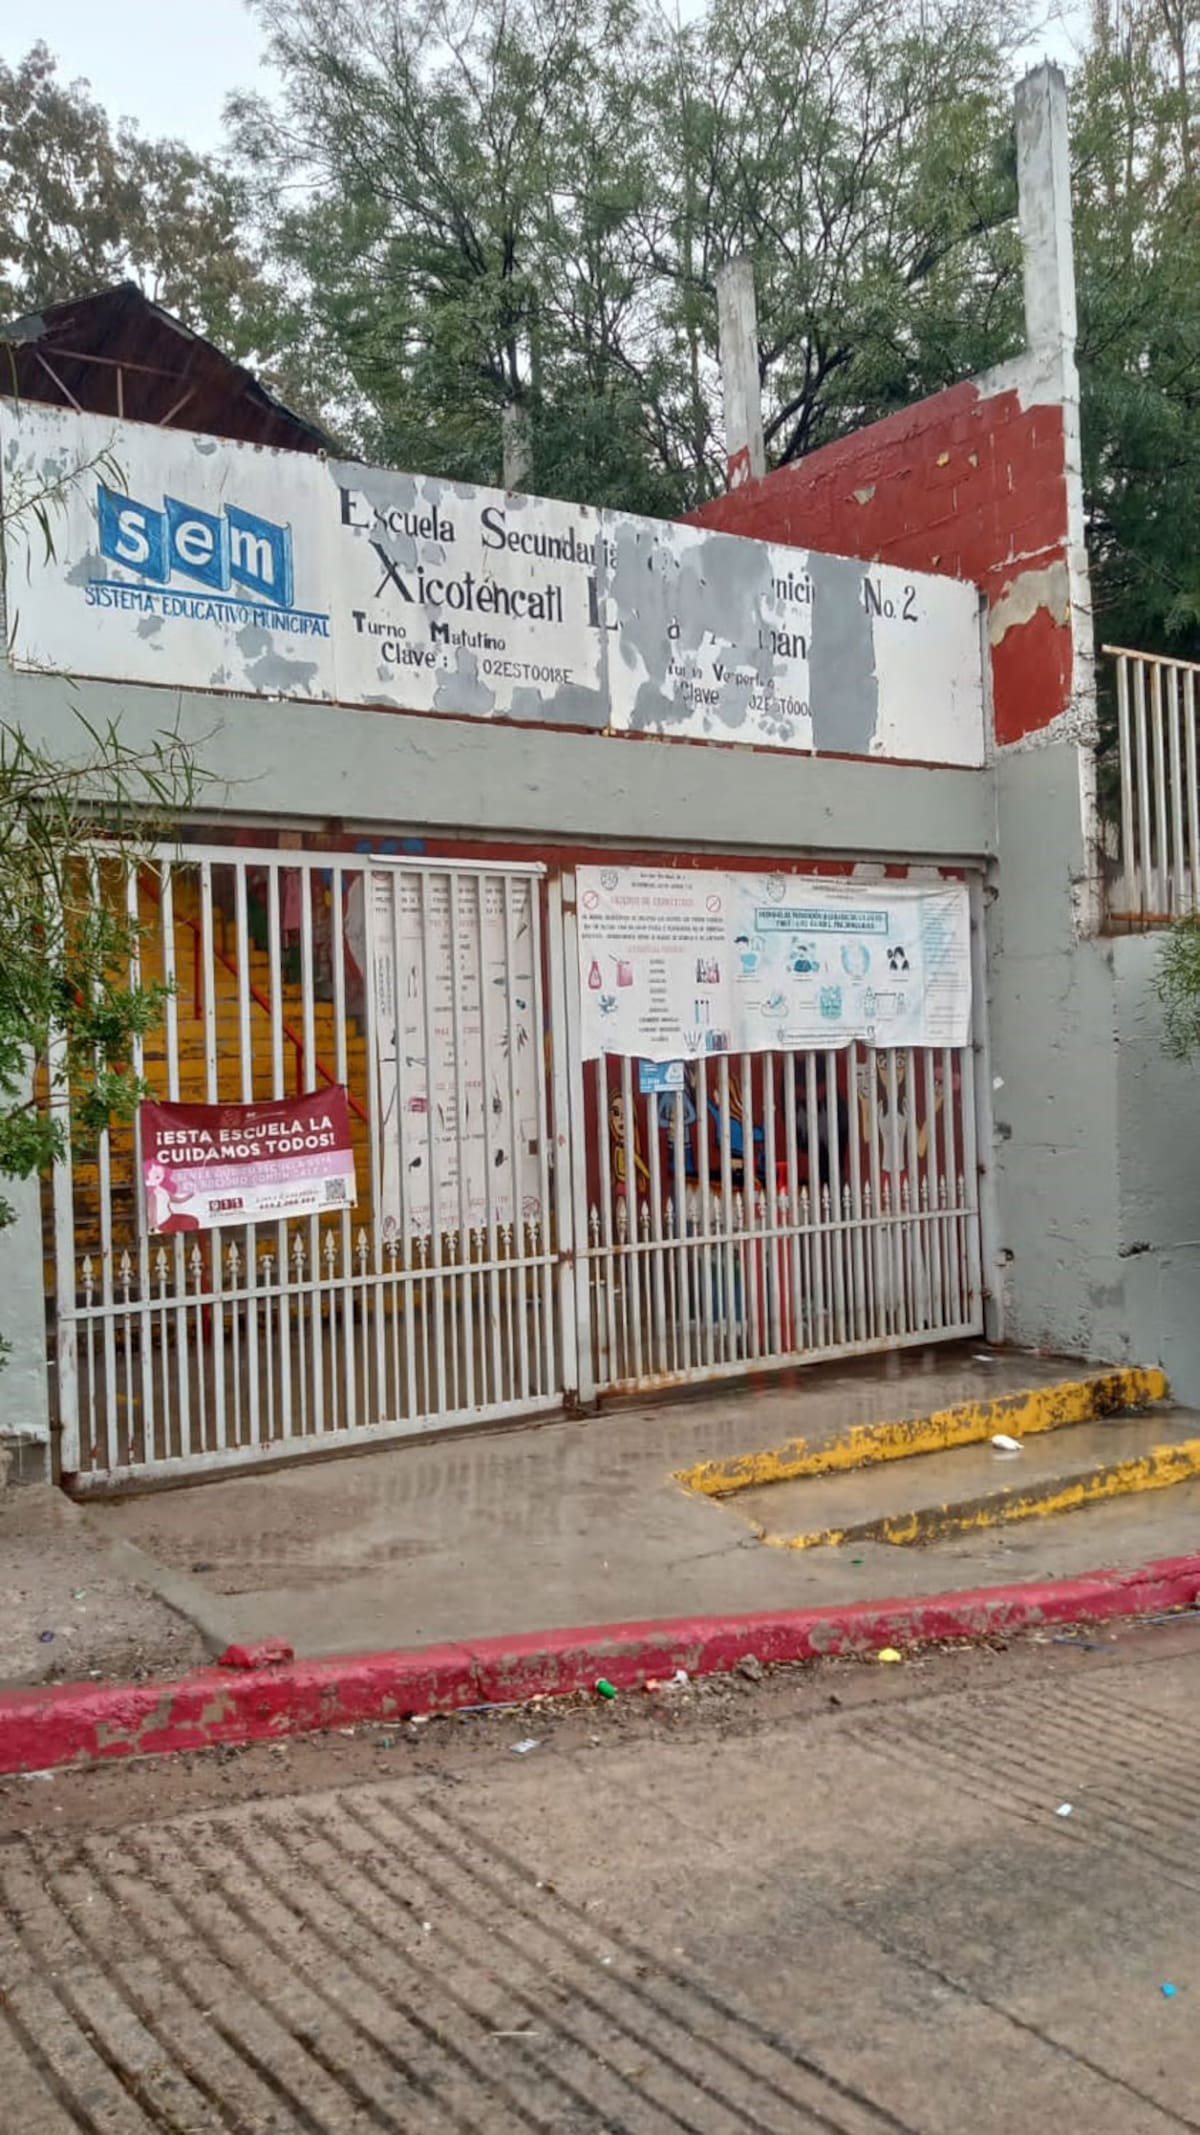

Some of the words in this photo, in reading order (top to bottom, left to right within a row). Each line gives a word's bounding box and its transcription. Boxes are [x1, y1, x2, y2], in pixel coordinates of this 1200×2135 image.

[340, 487, 456, 543] Escuela
[115, 508, 274, 586] sem
[85, 586, 157, 614] SISTEMA
[162, 596, 249, 624] EDUCATIVO
[253, 609, 331, 638] MUNICIPAL
[352, 611, 407, 639] Turno
[430, 621, 506, 652] Matutino
[156, 1129, 213, 1146] ¡ESTA
[219, 1118, 304, 1143] ESCUELA
[309, 1115, 333, 1131] LA
[156, 1143, 261, 1164] CUIDAMOS
[266, 1132, 336, 1154] TODOS!
